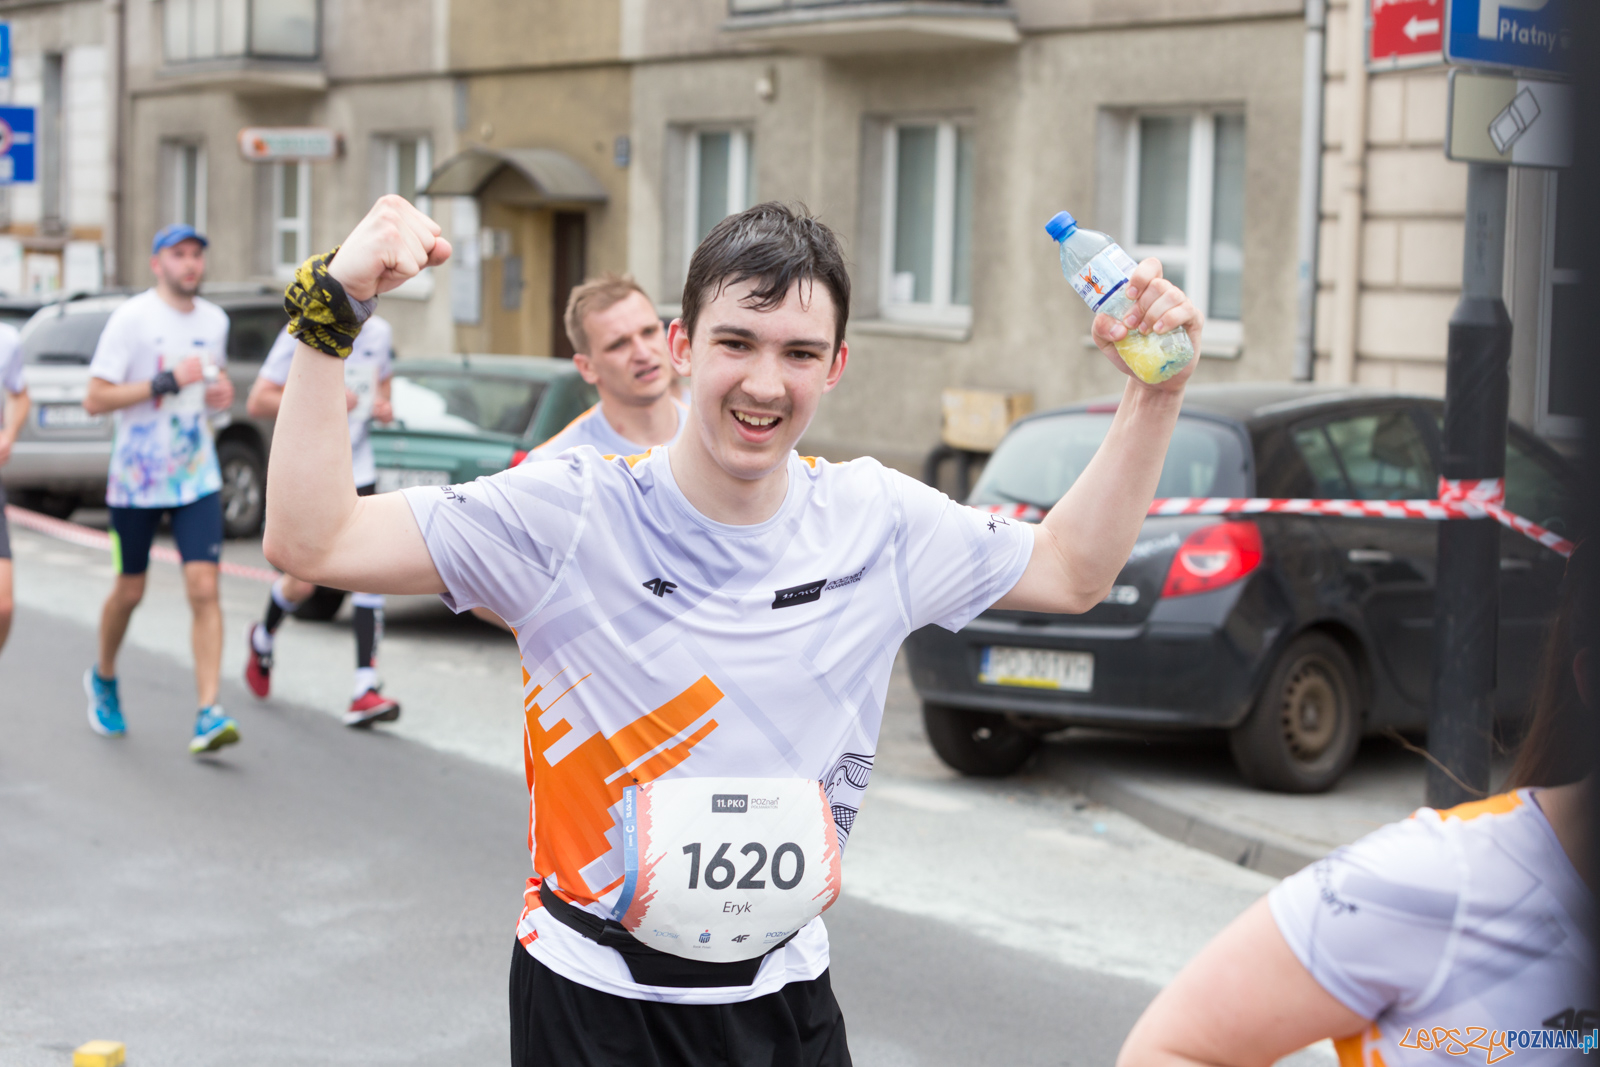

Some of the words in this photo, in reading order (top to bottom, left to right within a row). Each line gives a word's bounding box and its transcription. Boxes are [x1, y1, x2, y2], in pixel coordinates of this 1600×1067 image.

[642, 577, 678, 598] 4F
[625, 825, 635, 833] C
[682, 842, 805, 890] 1620
[722, 901, 752, 916] Eryk
[731, 934, 750, 943] 4F
